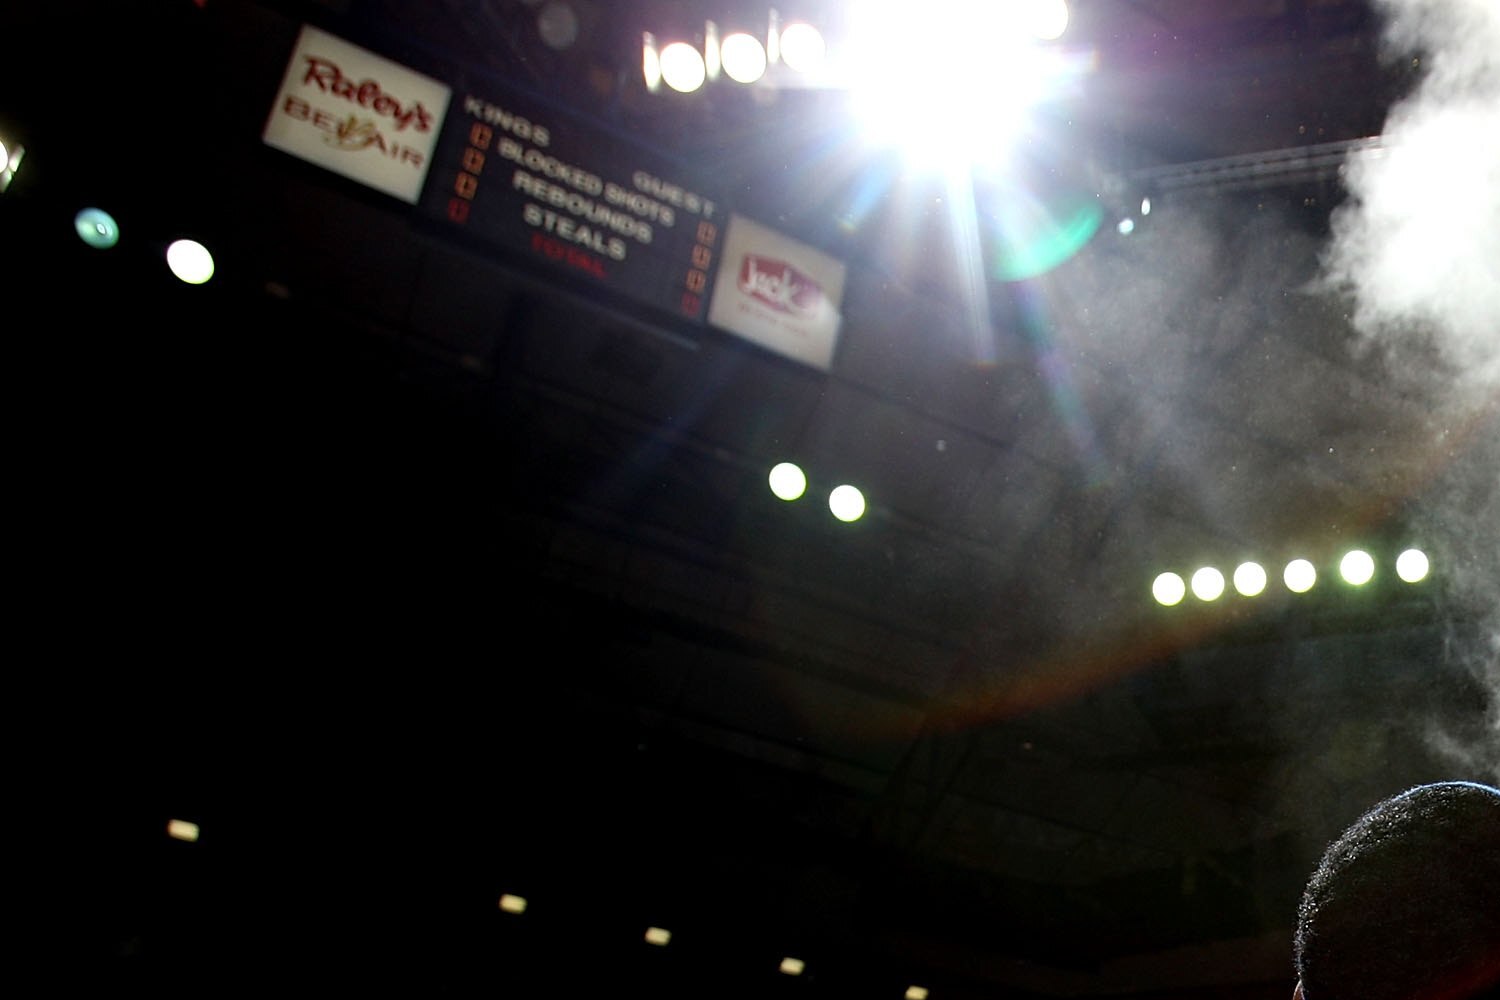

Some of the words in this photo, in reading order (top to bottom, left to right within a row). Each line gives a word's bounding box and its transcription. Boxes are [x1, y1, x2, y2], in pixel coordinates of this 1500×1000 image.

[304, 54, 432, 133] Raley's
[464, 95, 550, 147] KINGS
[498, 136, 603, 197] BLOCKED
[604, 182, 675, 227] SHOTS
[513, 169, 652, 244] REBOUNDS
[633, 170, 716, 219] GUEST
[523, 203, 626, 261] STEALS
